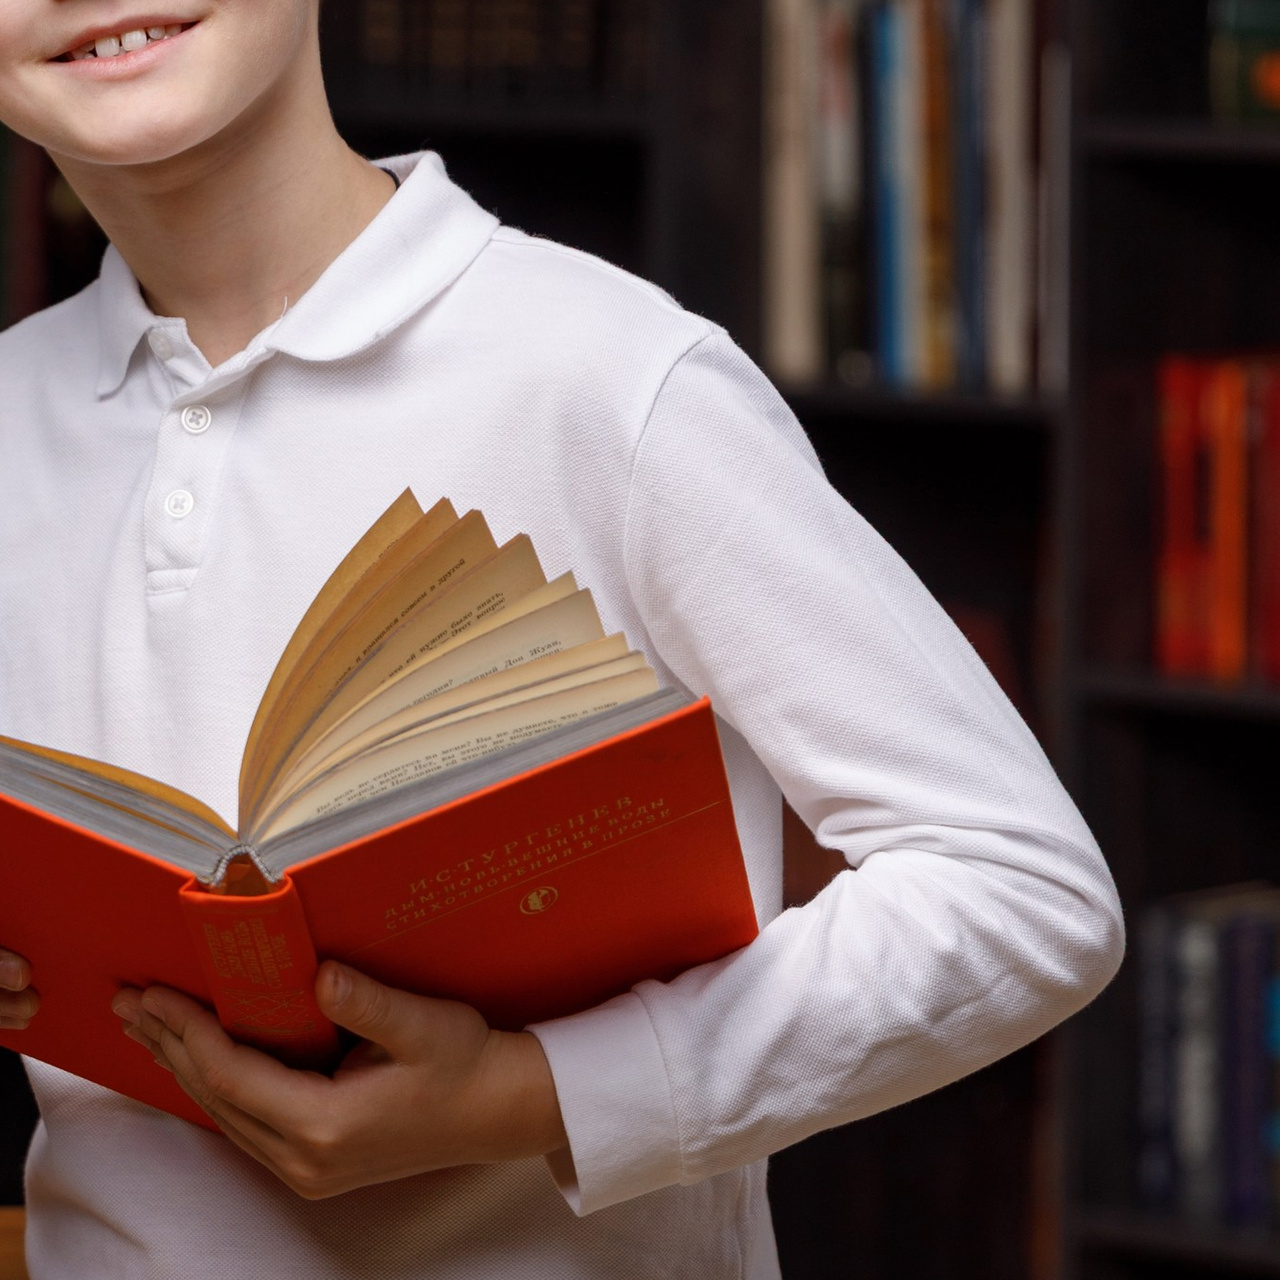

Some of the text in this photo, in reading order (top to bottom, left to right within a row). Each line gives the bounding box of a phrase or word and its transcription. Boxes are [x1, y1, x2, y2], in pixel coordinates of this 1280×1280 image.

[608, 799, 664, 827] ВОДЫ
[386, 808, 671, 930] СТИХОТВОРЕНИЯ В ПРОЗЕ
